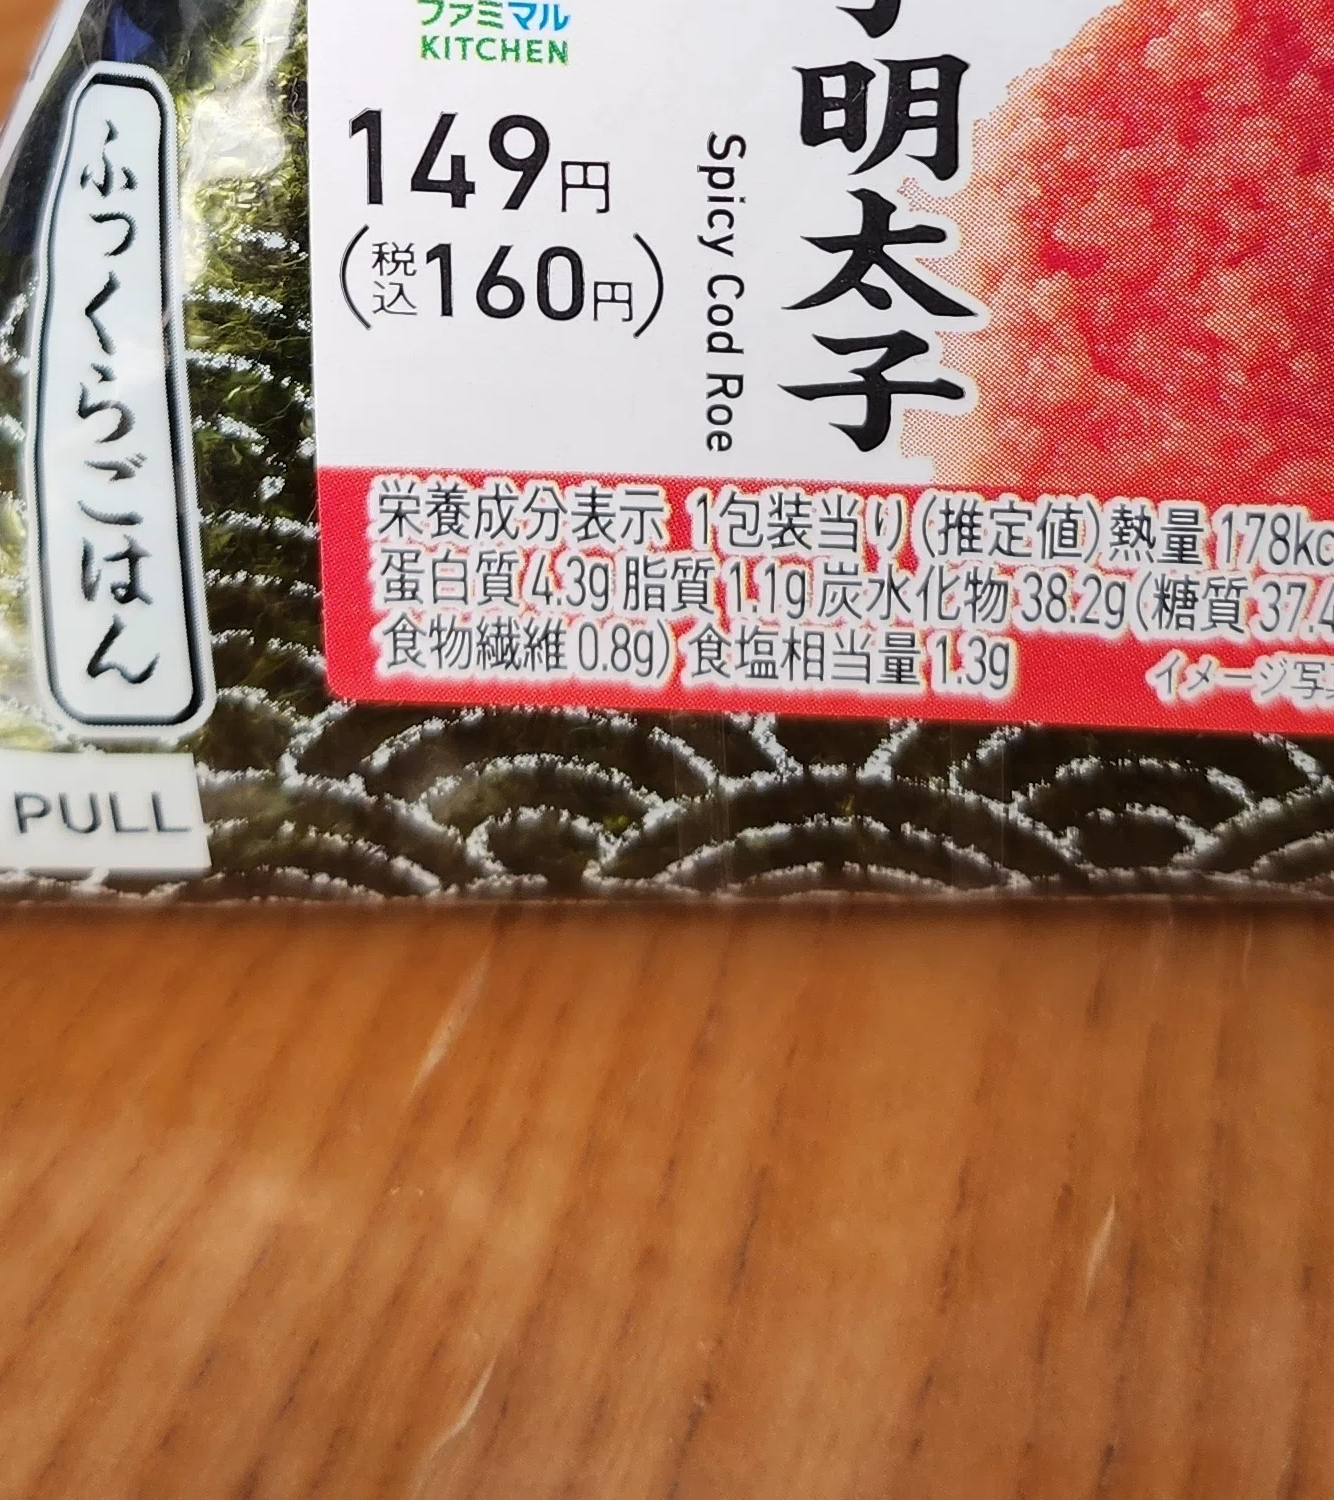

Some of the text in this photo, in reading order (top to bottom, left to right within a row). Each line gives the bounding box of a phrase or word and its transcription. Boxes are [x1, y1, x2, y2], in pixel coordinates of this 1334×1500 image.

[420, 35, 569, 65] KITCHEN
[697, 131, 747, 453] Spicy Cod Roe
[376, 480, 666, 546] 栄養成分表示
[13, 791, 192, 836] PULL
